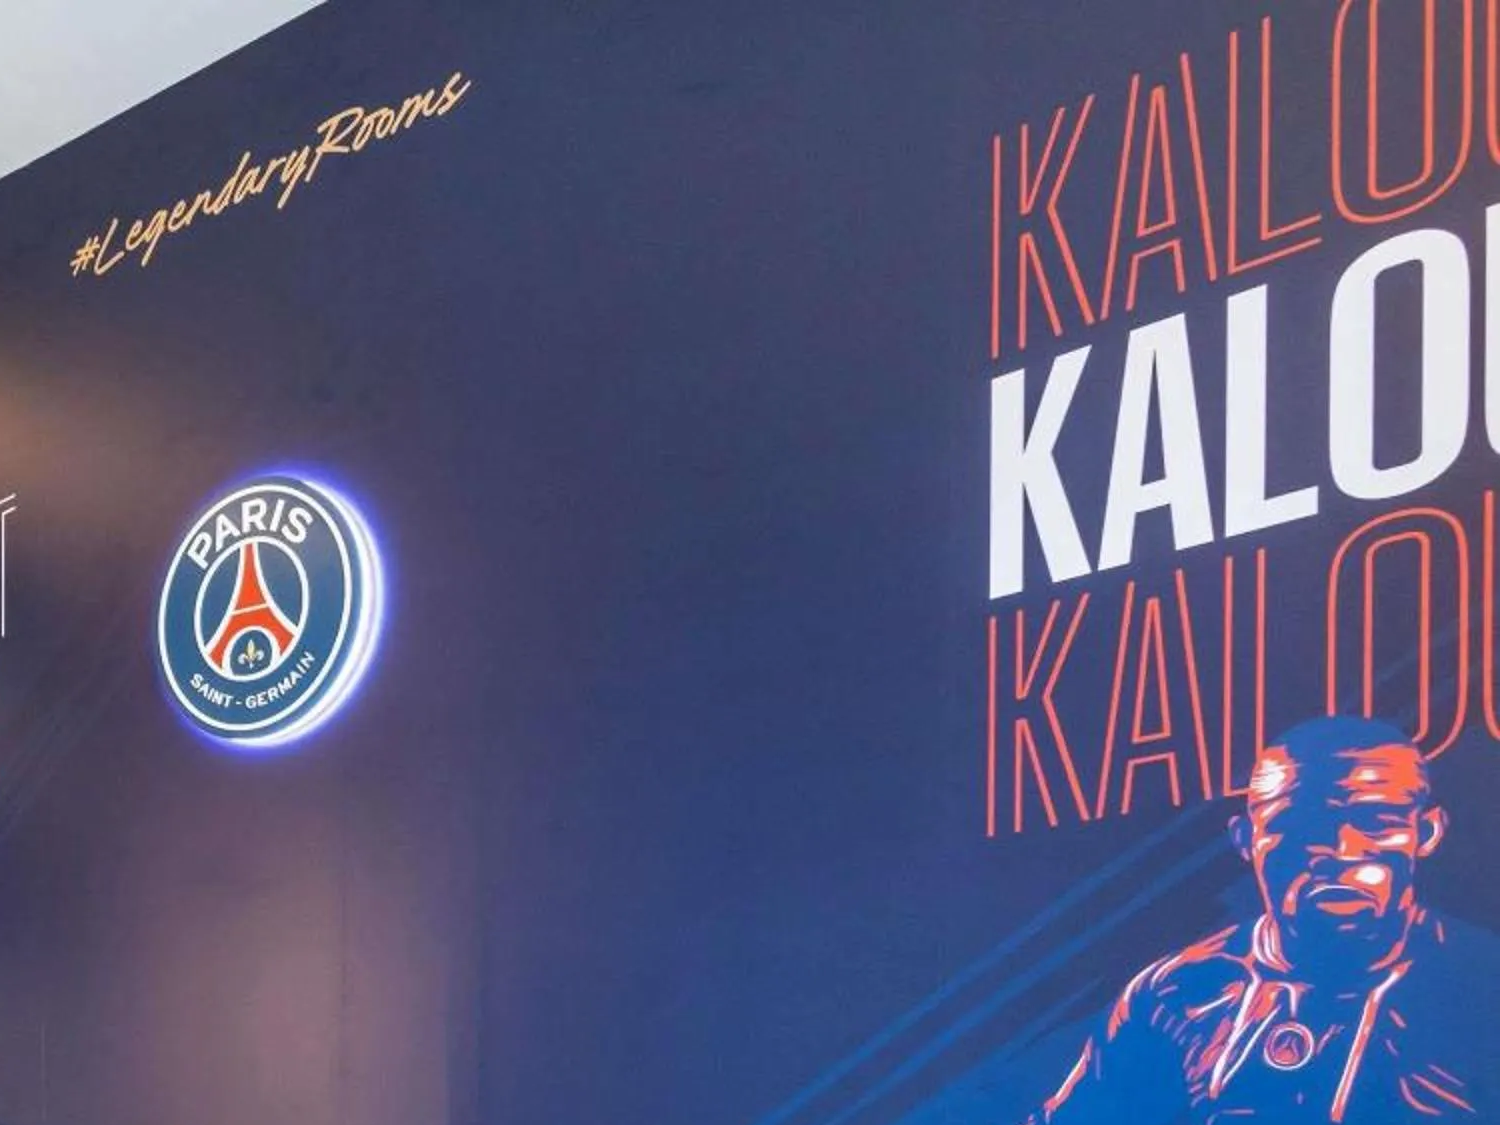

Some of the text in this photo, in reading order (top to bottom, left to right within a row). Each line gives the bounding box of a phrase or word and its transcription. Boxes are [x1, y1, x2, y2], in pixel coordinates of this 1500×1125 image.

[70, 72, 471, 276] #LegendaryRooms
[991, 0, 1500, 360] KALO
[187, 498, 313, 570] PARIS
[989, 202, 1500, 601] KALO
[986, 489, 1500, 838] KALO
